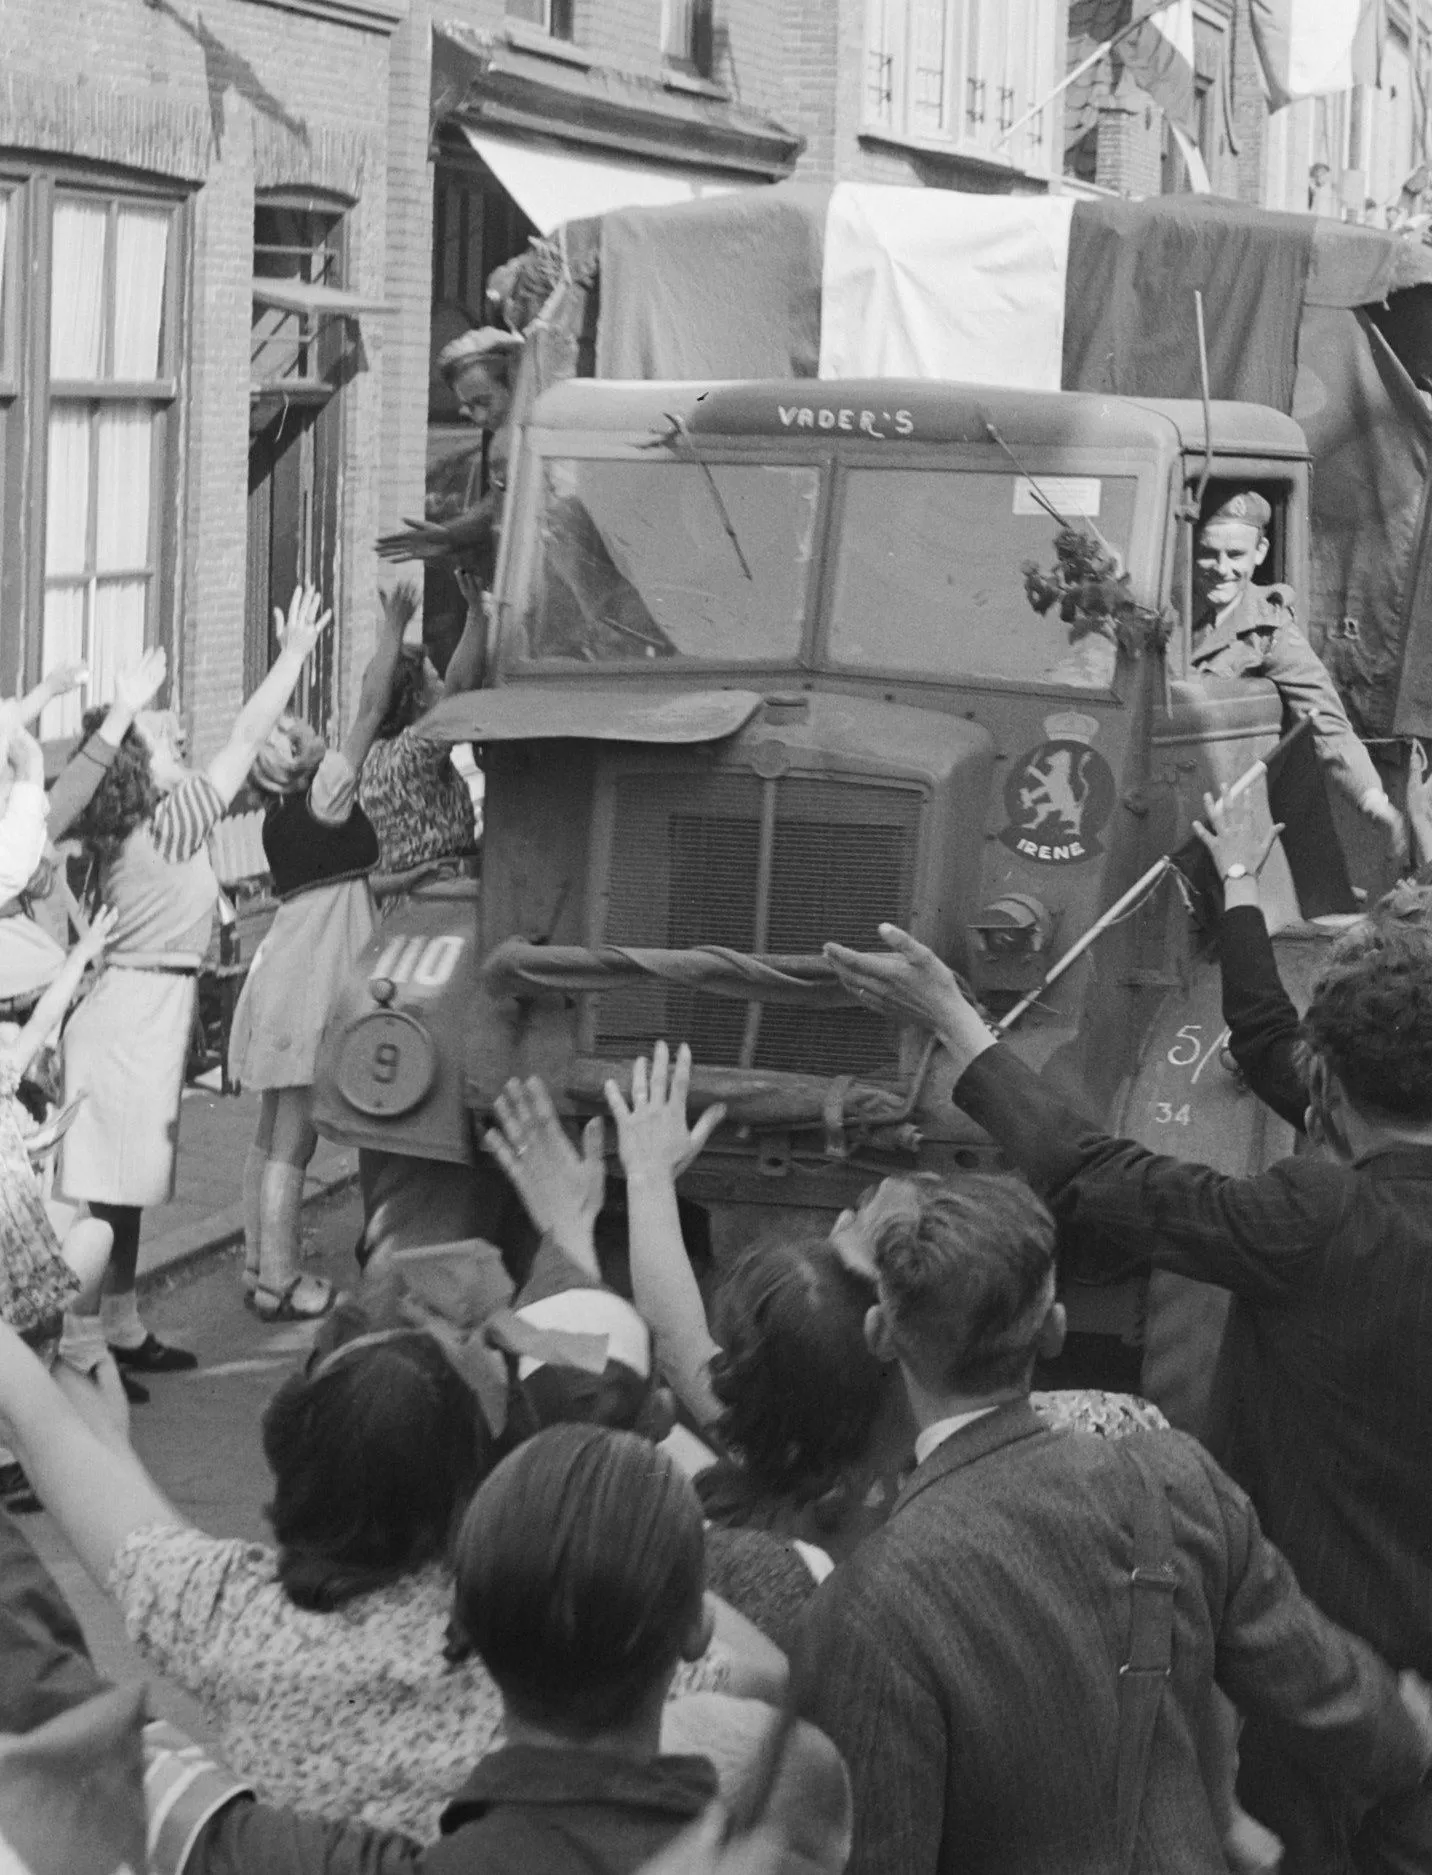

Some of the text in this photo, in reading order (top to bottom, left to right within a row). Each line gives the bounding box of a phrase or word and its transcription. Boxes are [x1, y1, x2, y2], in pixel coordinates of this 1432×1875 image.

[777, 404, 914, 439] VADER'S
[1016, 838, 1086, 860] IRENE
[368, 935, 465, 985] 110
[373, 1042, 400, 1084] 9
[1155, 1102, 1192, 1126] 34
